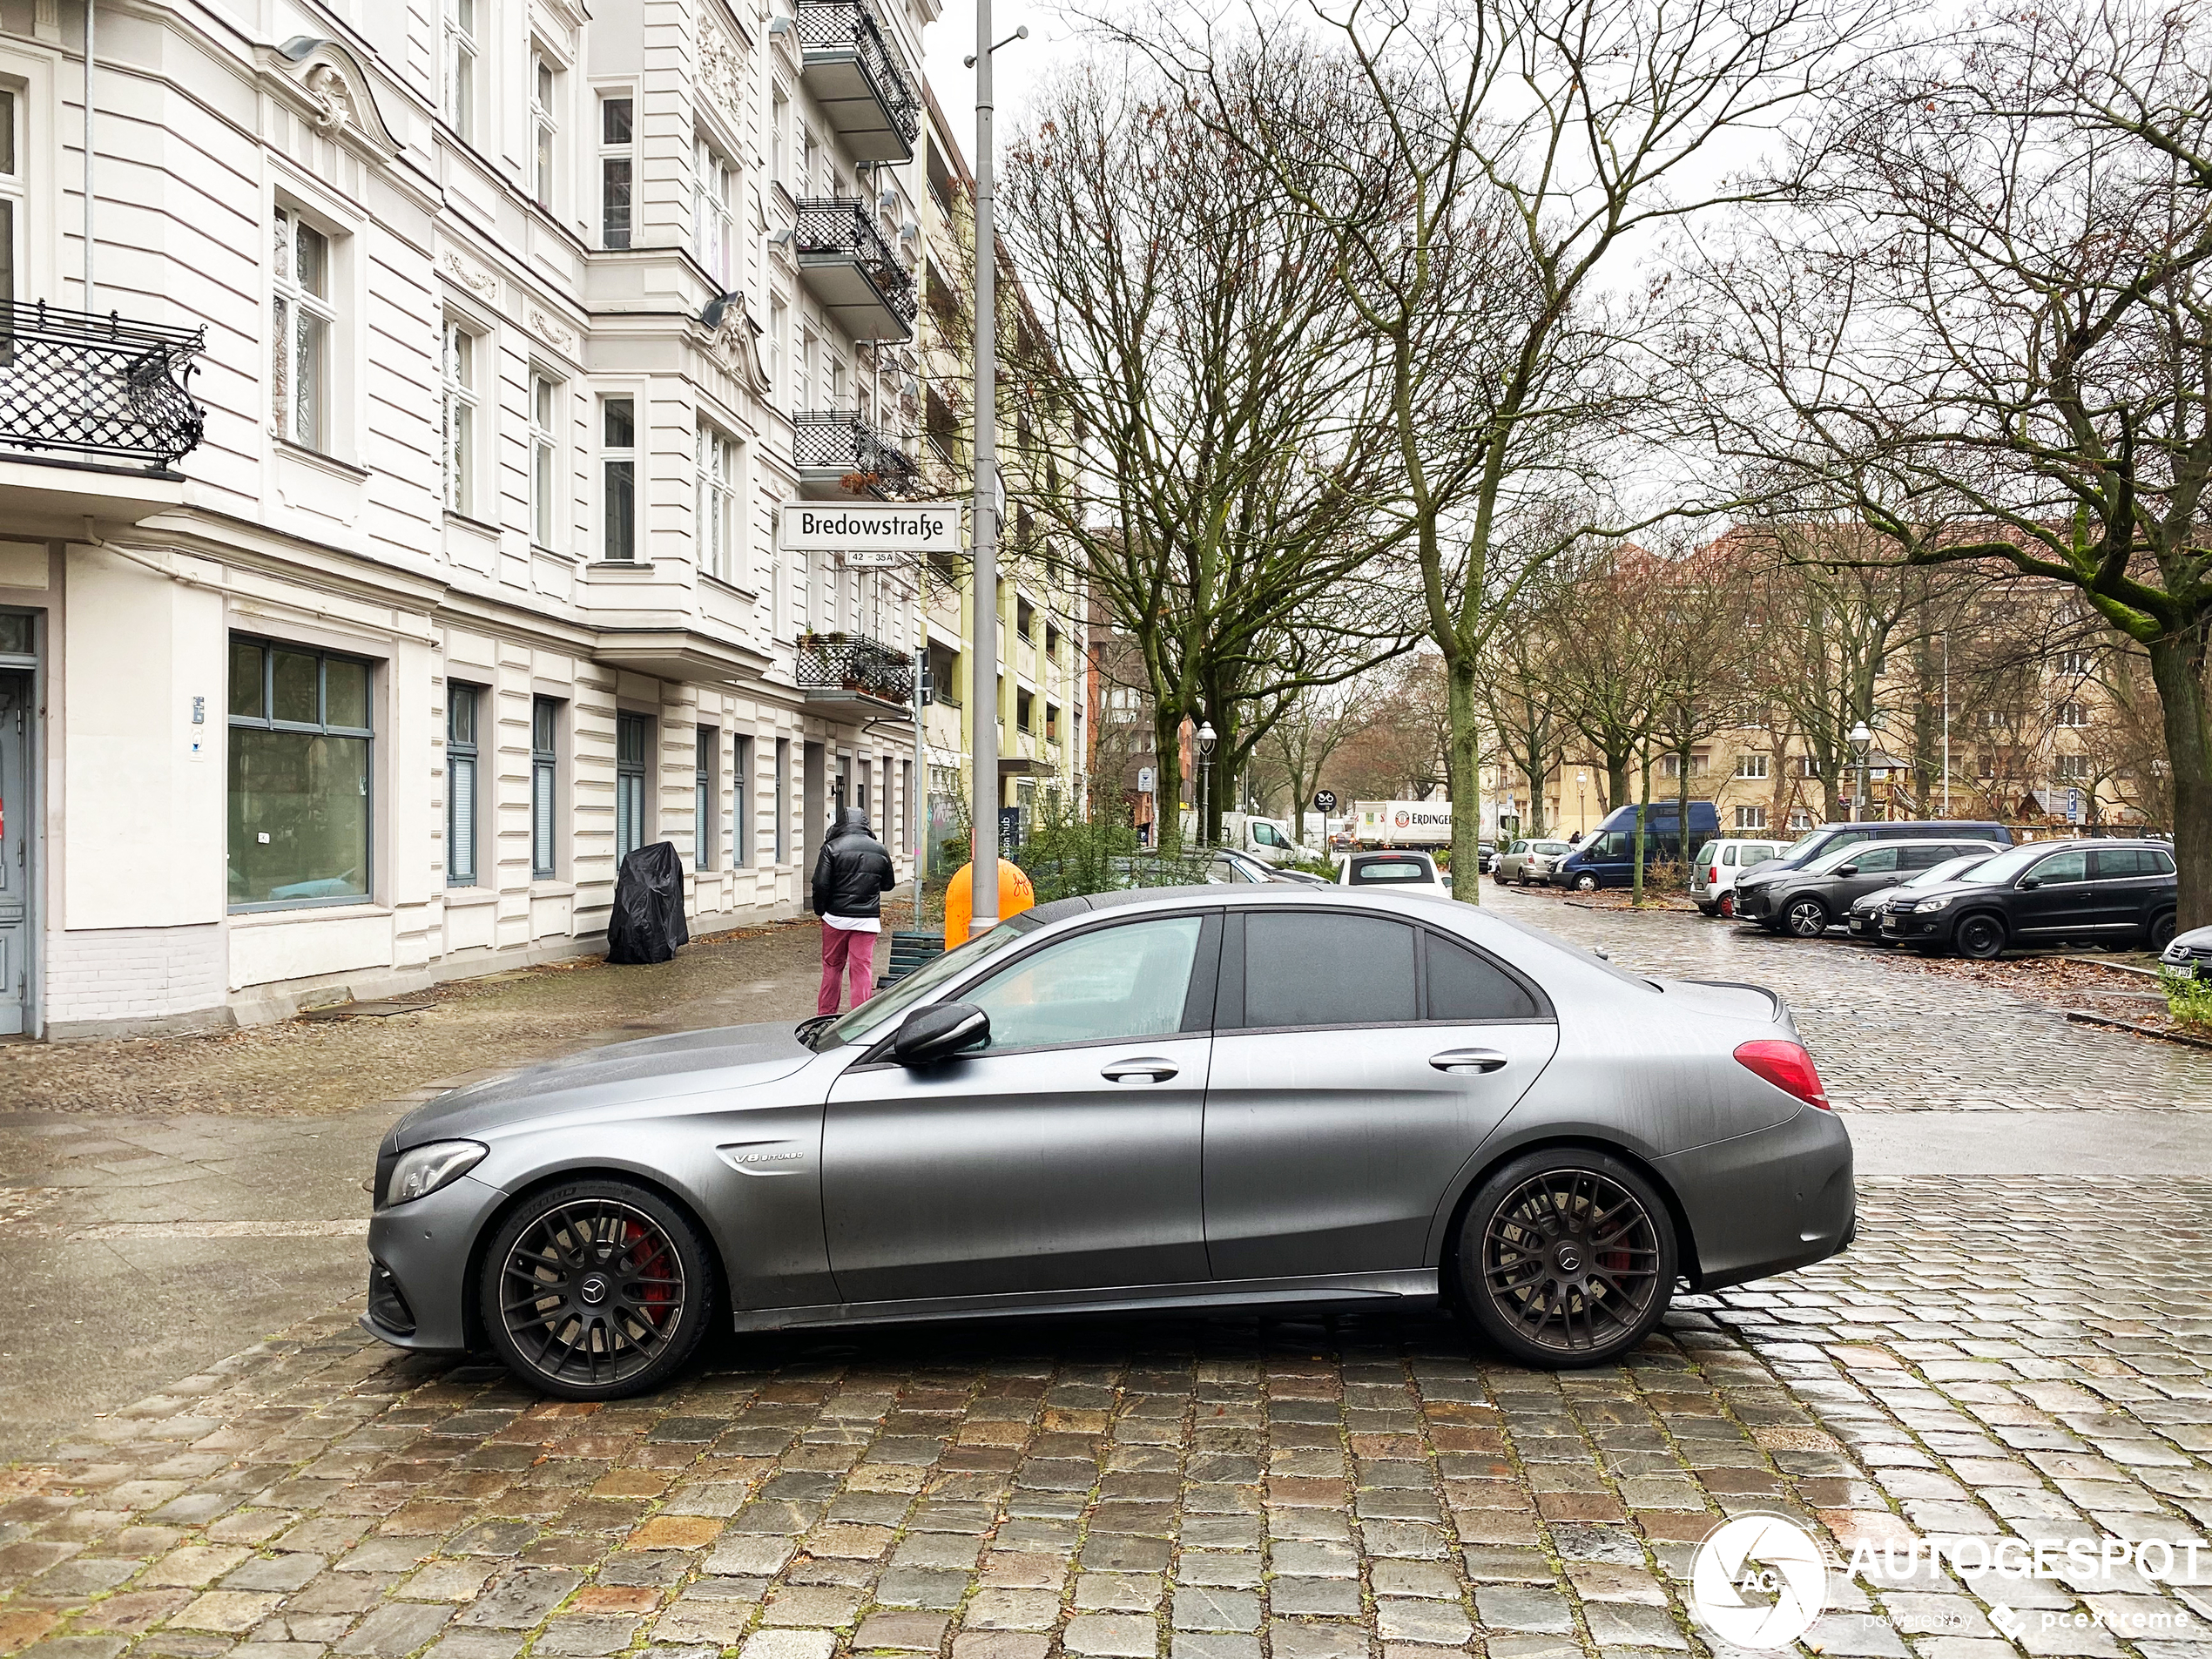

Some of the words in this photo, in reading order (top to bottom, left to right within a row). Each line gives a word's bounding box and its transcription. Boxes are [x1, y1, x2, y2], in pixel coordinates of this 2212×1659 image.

[802, 512, 943, 541] Bredowstraße
[875, 553, 893, 562] 35A
[1001, 817, 1010, 836] hub
[733, 1153, 760, 1163] V8
[760, 1151, 804, 1162] BITURBO
